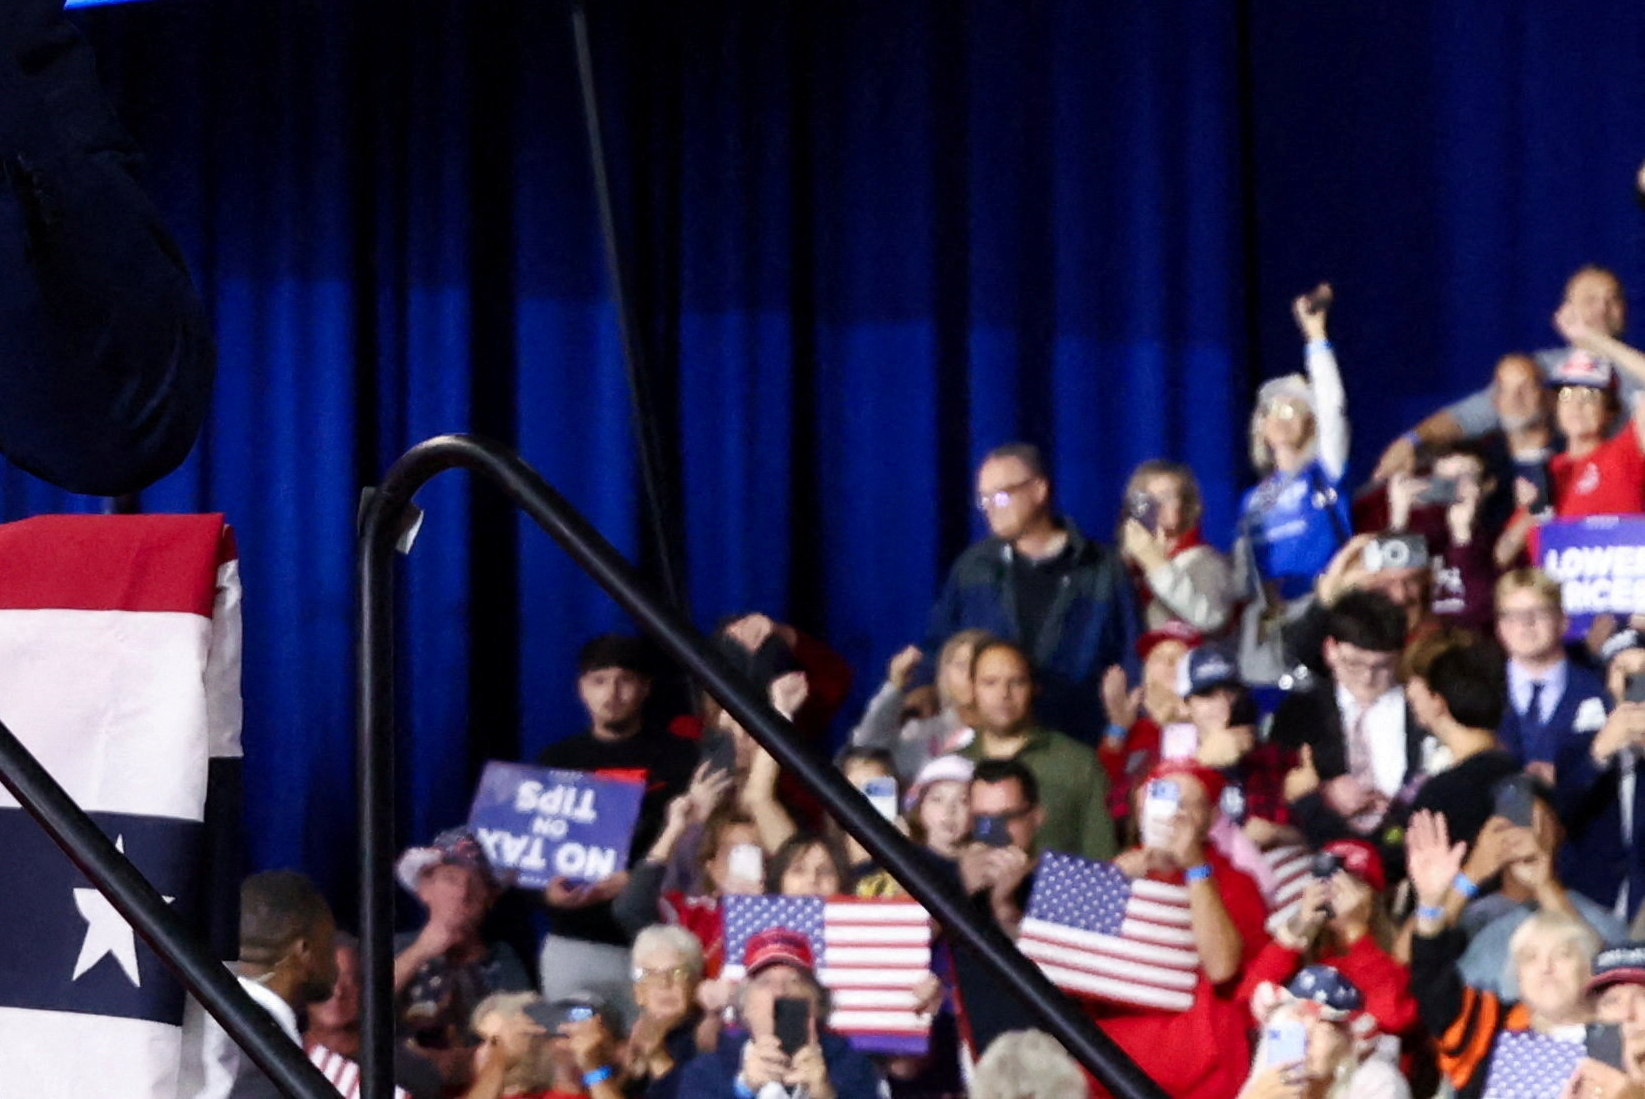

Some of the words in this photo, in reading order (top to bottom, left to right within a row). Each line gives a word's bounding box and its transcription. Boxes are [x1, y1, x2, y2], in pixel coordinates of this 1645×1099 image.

[514, 780, 598, 824] TIPS
[477, 826, 547, 872] TAX
[531, 815, 570, 842] ON
[555, 841, 618, 883] NO
